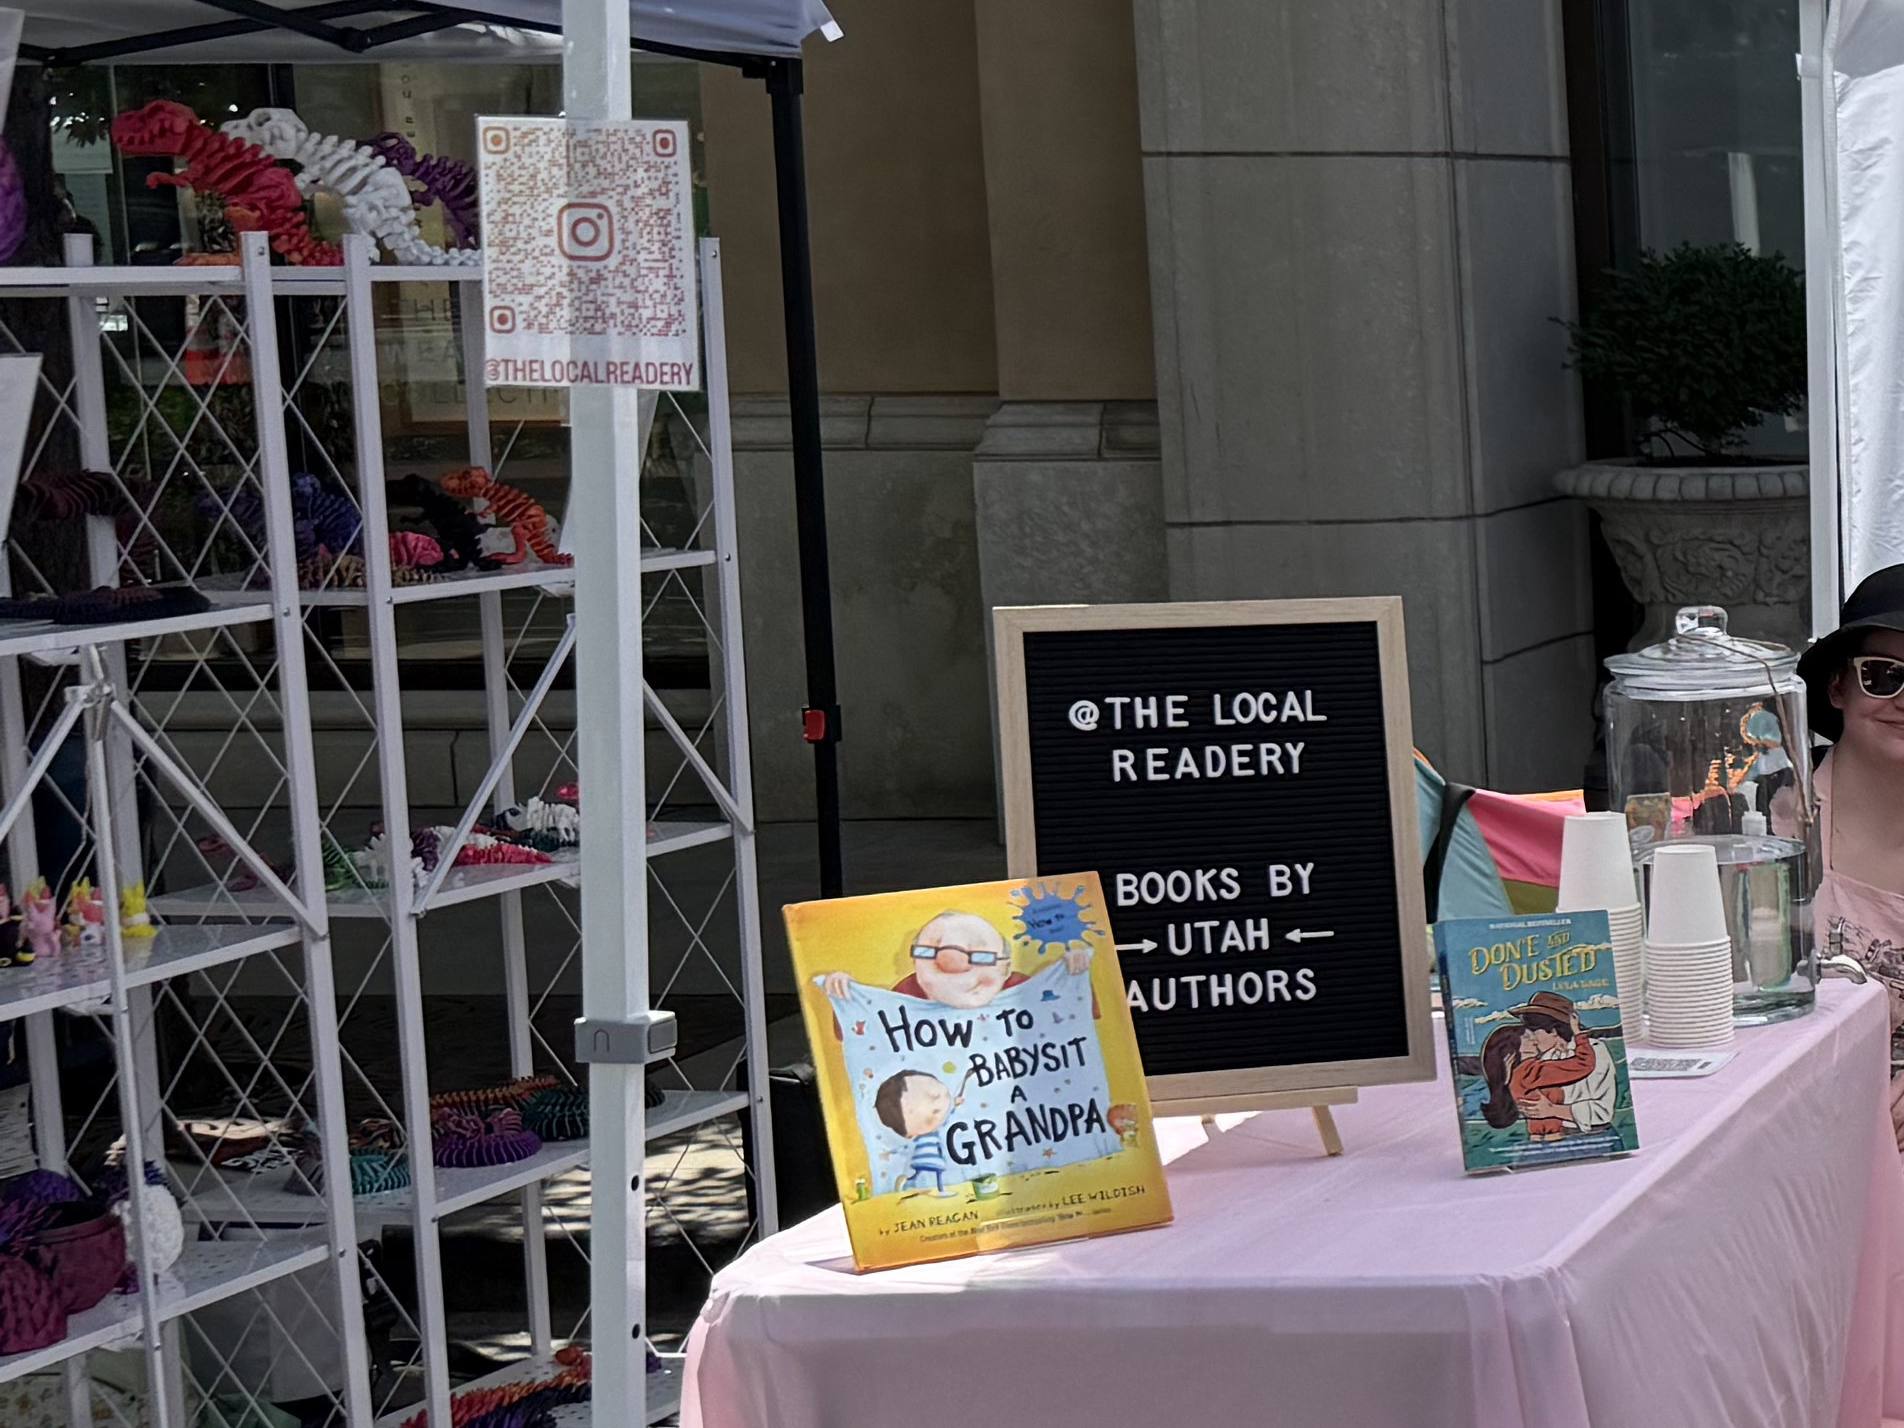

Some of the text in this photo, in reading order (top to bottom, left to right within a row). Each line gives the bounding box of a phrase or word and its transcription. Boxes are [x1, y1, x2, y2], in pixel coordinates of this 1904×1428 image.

[485, 359, 694, 386] @THELOCALREADERY
[1068, 689, 1328, 731] @THE LOCAL
[1113, 741, 1306, 783] READERY
[1116, 862, 1315, 907] BOOKS BY
[1168, 917, 1270, 956] UTAH
[1547, 931, 1571, 949] AND
[1502, 946, 1598, 992] DUSTED
[1126, 968, 1317, 1013] AUTHORS
[968, 1037, 1087, 1087] BABYSIT
[1010, 1084, 1027, 1104] A
[945, 1097, 1107, 1167] GRANDPA
[1061, 1195, 1085, 1209] LEE
[893, 1218, 926, 1234] JEAN
